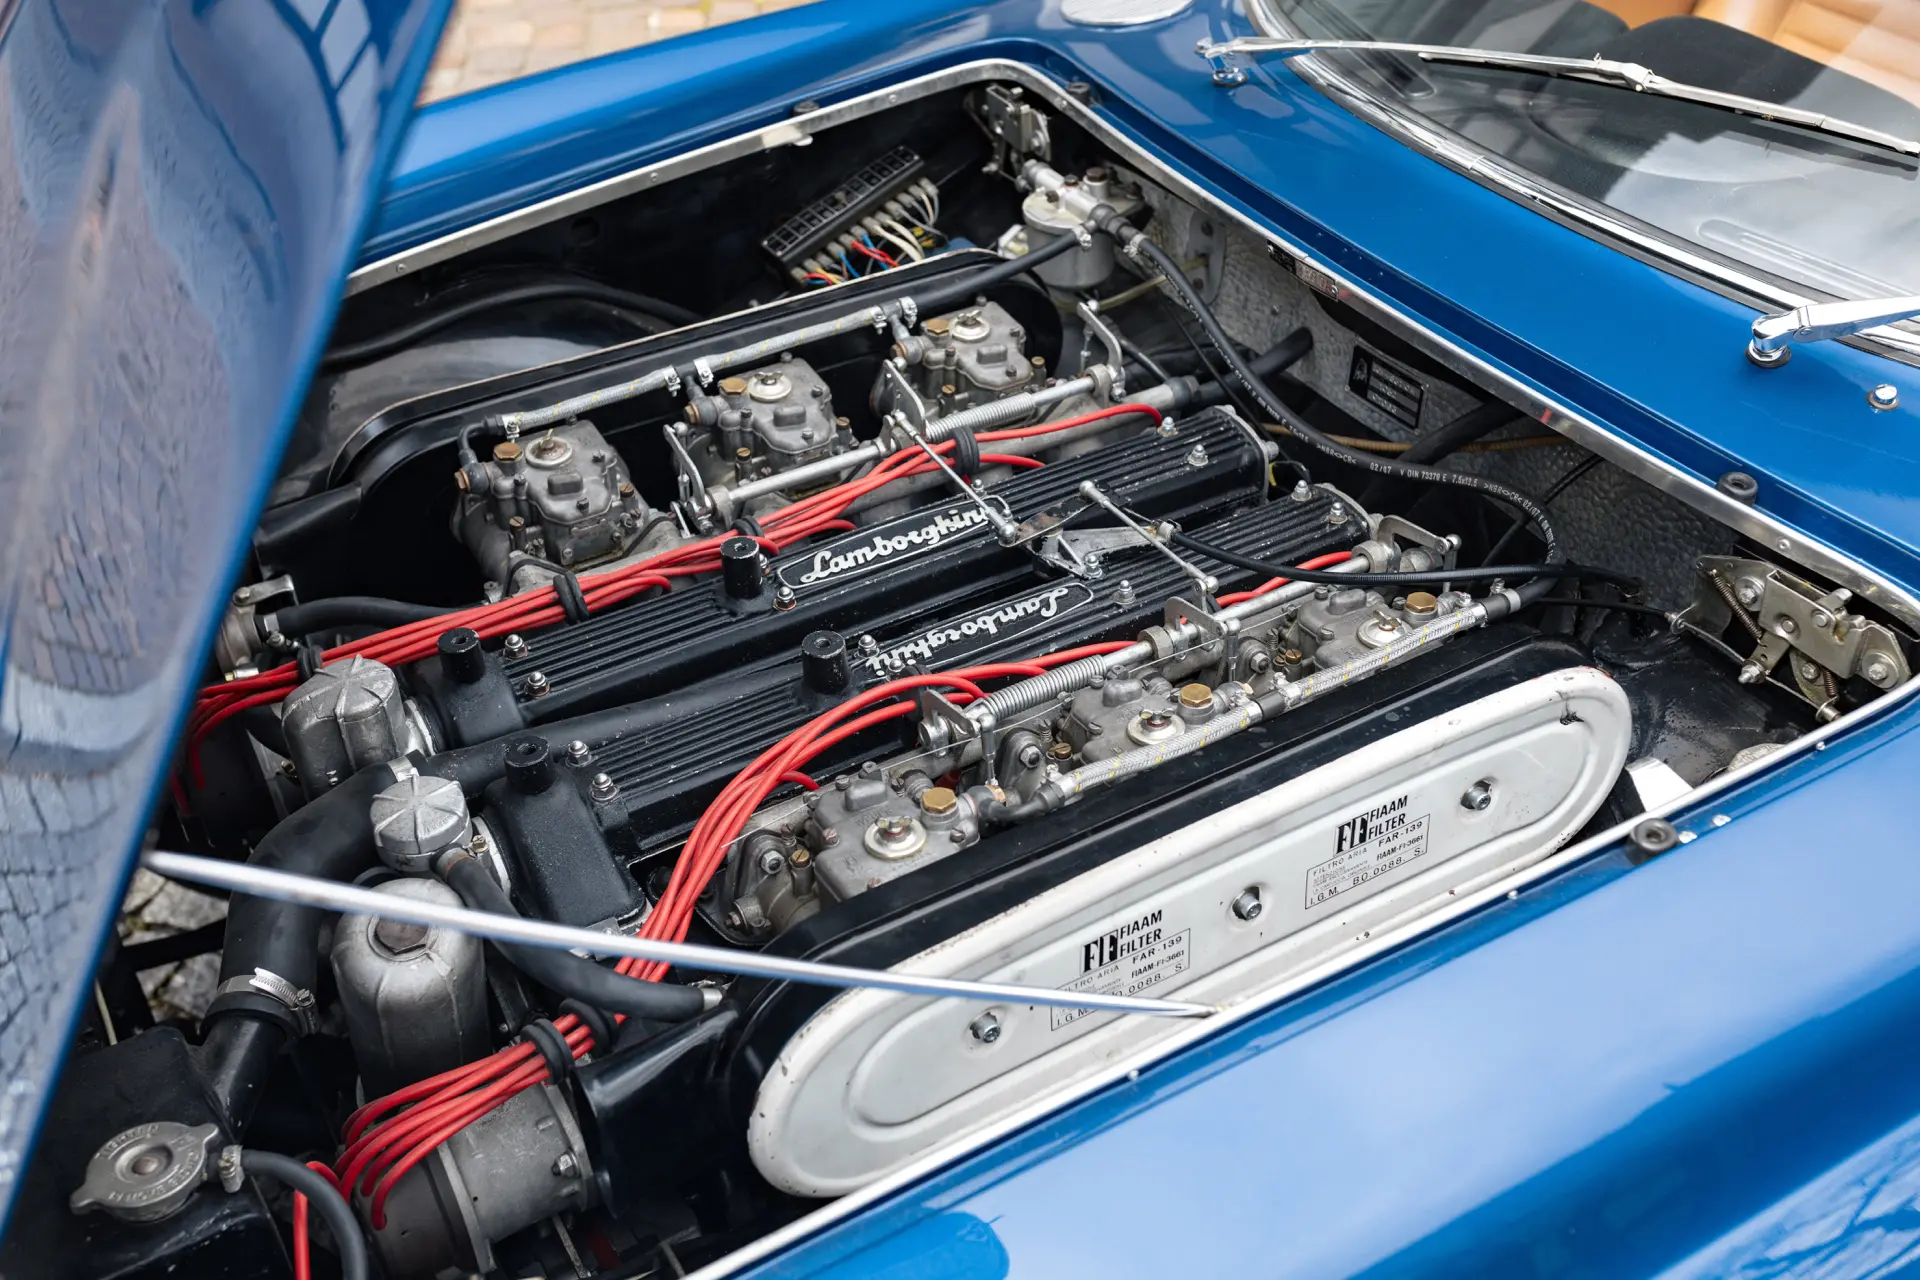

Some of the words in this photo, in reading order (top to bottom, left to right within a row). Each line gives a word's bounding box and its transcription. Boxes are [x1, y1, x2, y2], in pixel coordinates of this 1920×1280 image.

[866, 587, 1069, 677] Lamborghini
[1369, 795, 1408, 823] FIAAM
[1368, 813, 1406, 840] FILTER
[1313, 858, 1344, 876] FILTRO
[1347, 847, 1368, 860] ARIA
[1120, 909, 1162, 940] FIAAM
[1119, 928, 1162, 957] FILTER
[1097, 965, 1120, 979] ARIA
